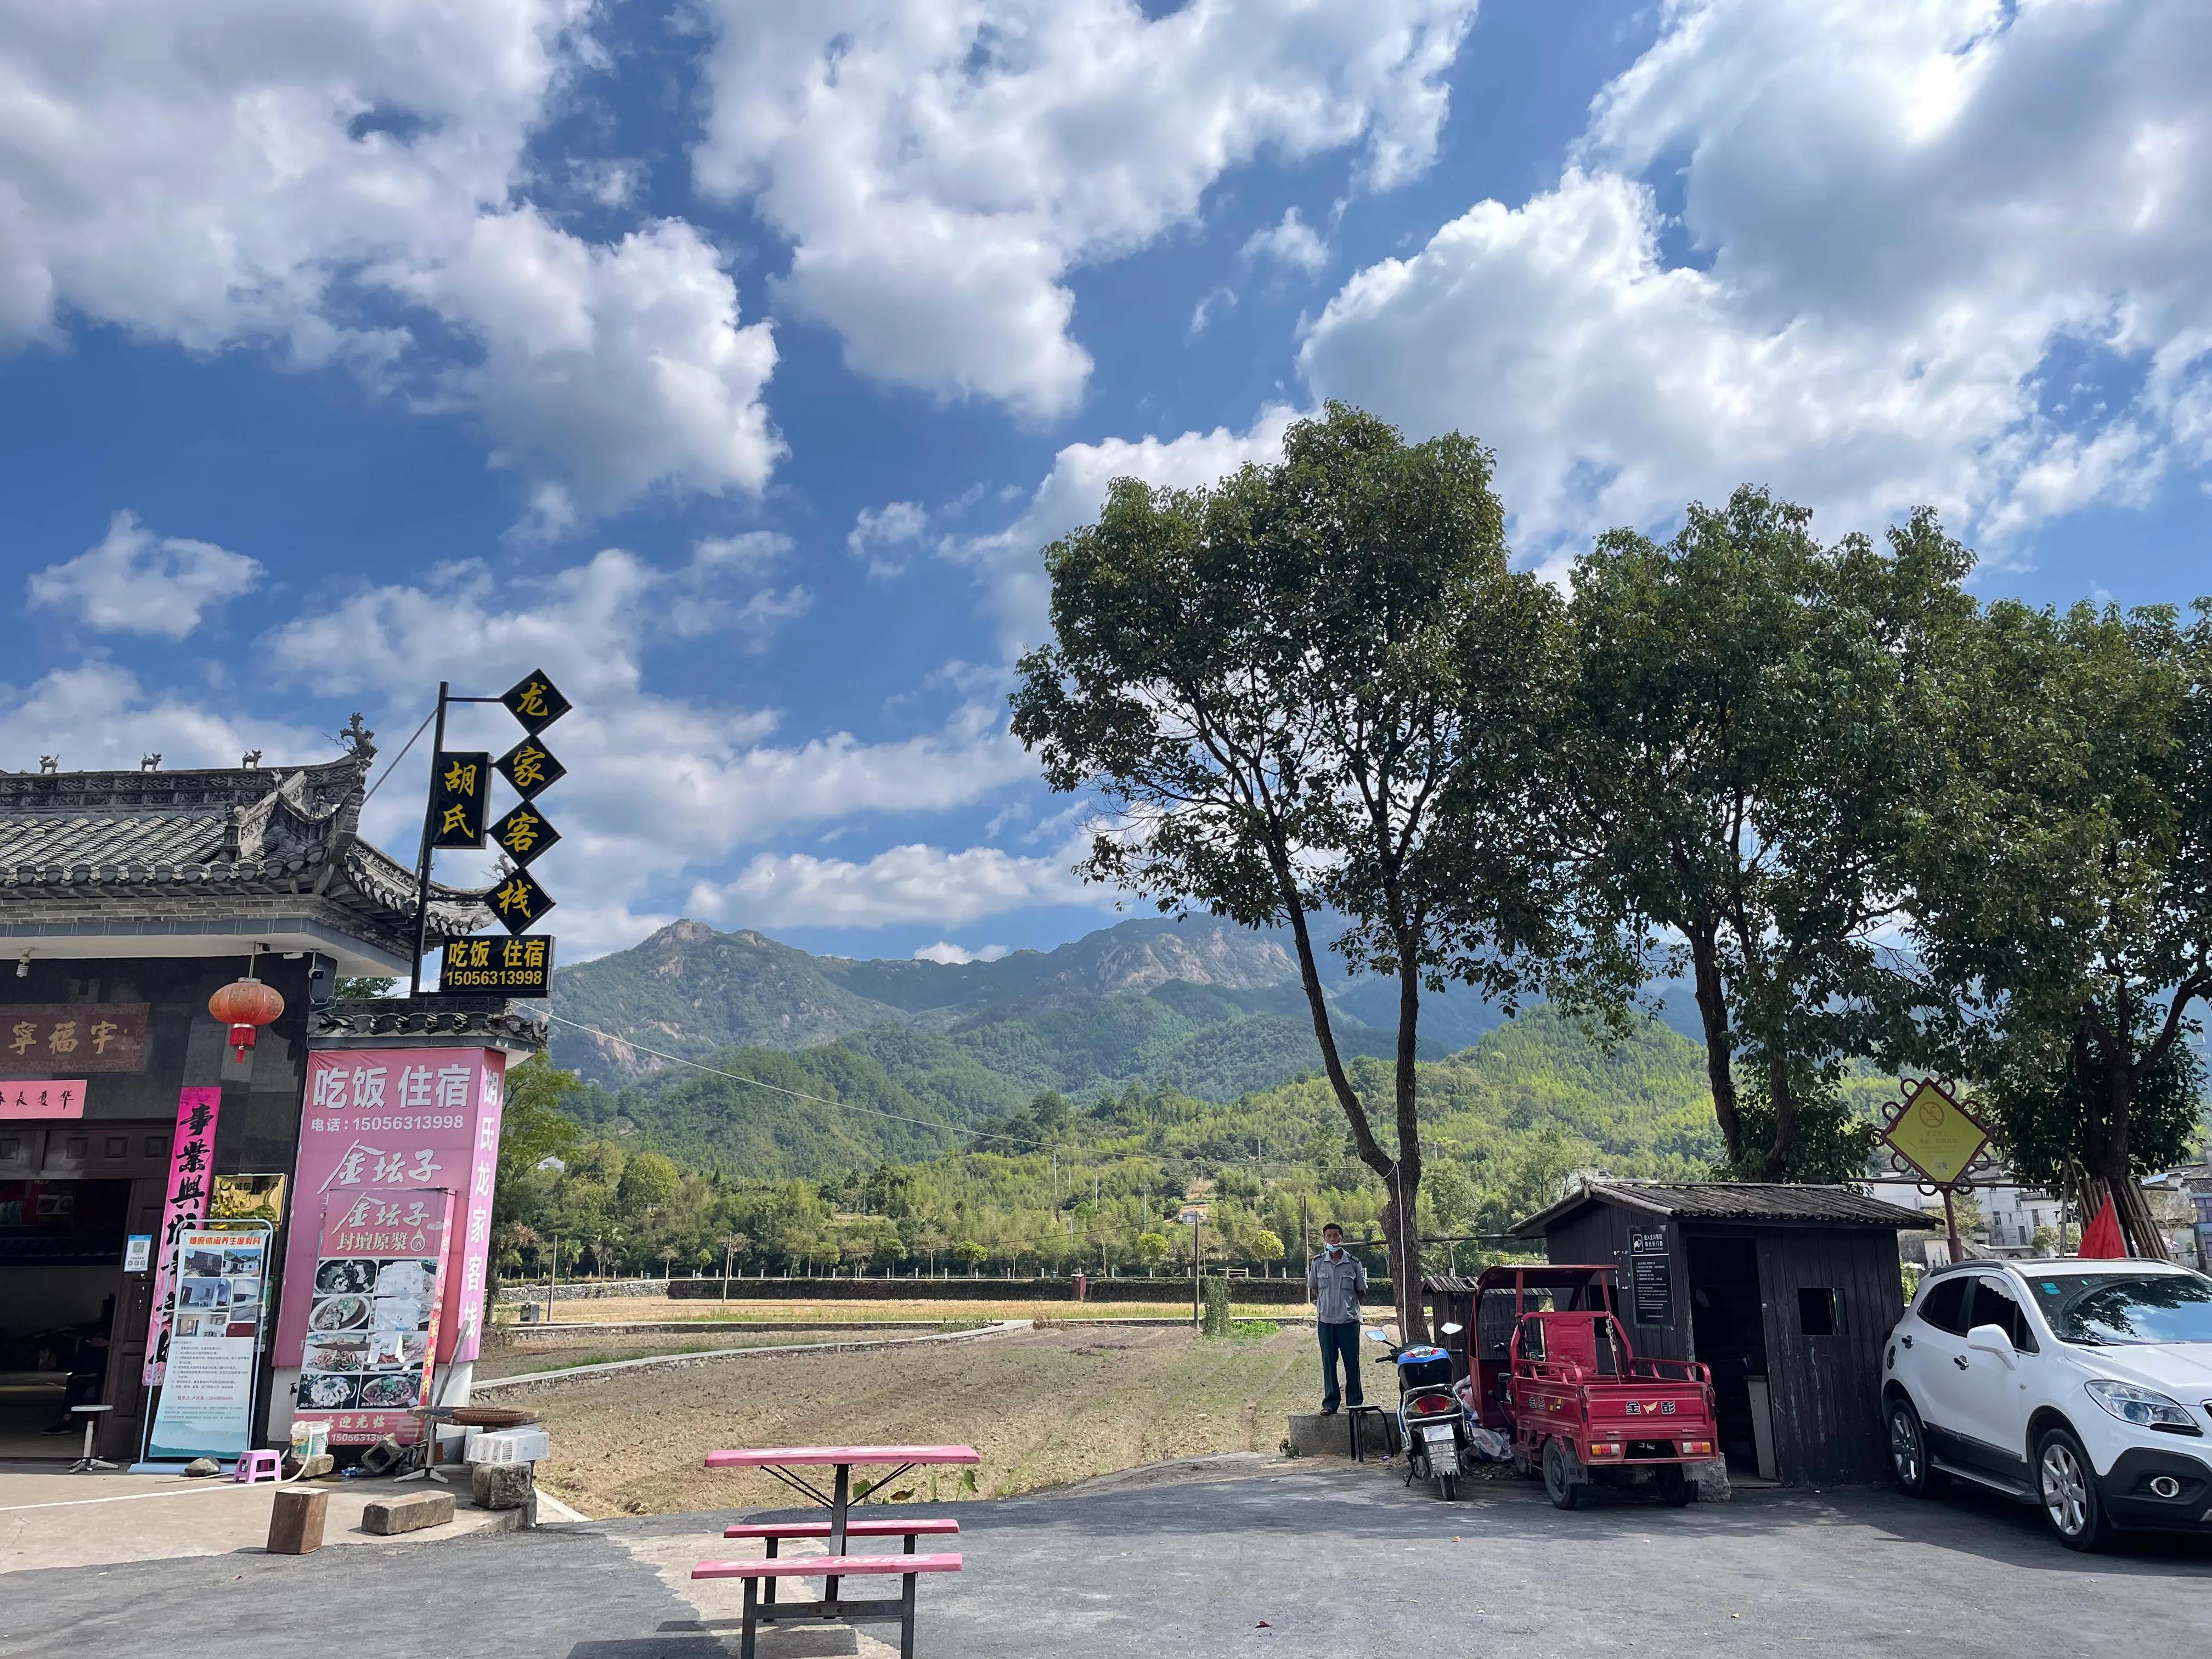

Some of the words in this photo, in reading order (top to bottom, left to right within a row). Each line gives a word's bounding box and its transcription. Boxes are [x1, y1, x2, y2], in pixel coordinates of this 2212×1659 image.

[442, 761, 477, 838] 胡氏
[498, 684, 548, 918] 龙家客栈
[448, 940, 490, 968] 吃饭
[503, 939, 545, 967] 住宿
[447, 970, 542, 986] 15056313998
[313, 1066, 387, 1109] 吃饭
[398, 1064, 471, 1108] 住宿
[317, 1139, 442, 1195] 金坛子
[331, 1192, 430, 1234] 金坛子
